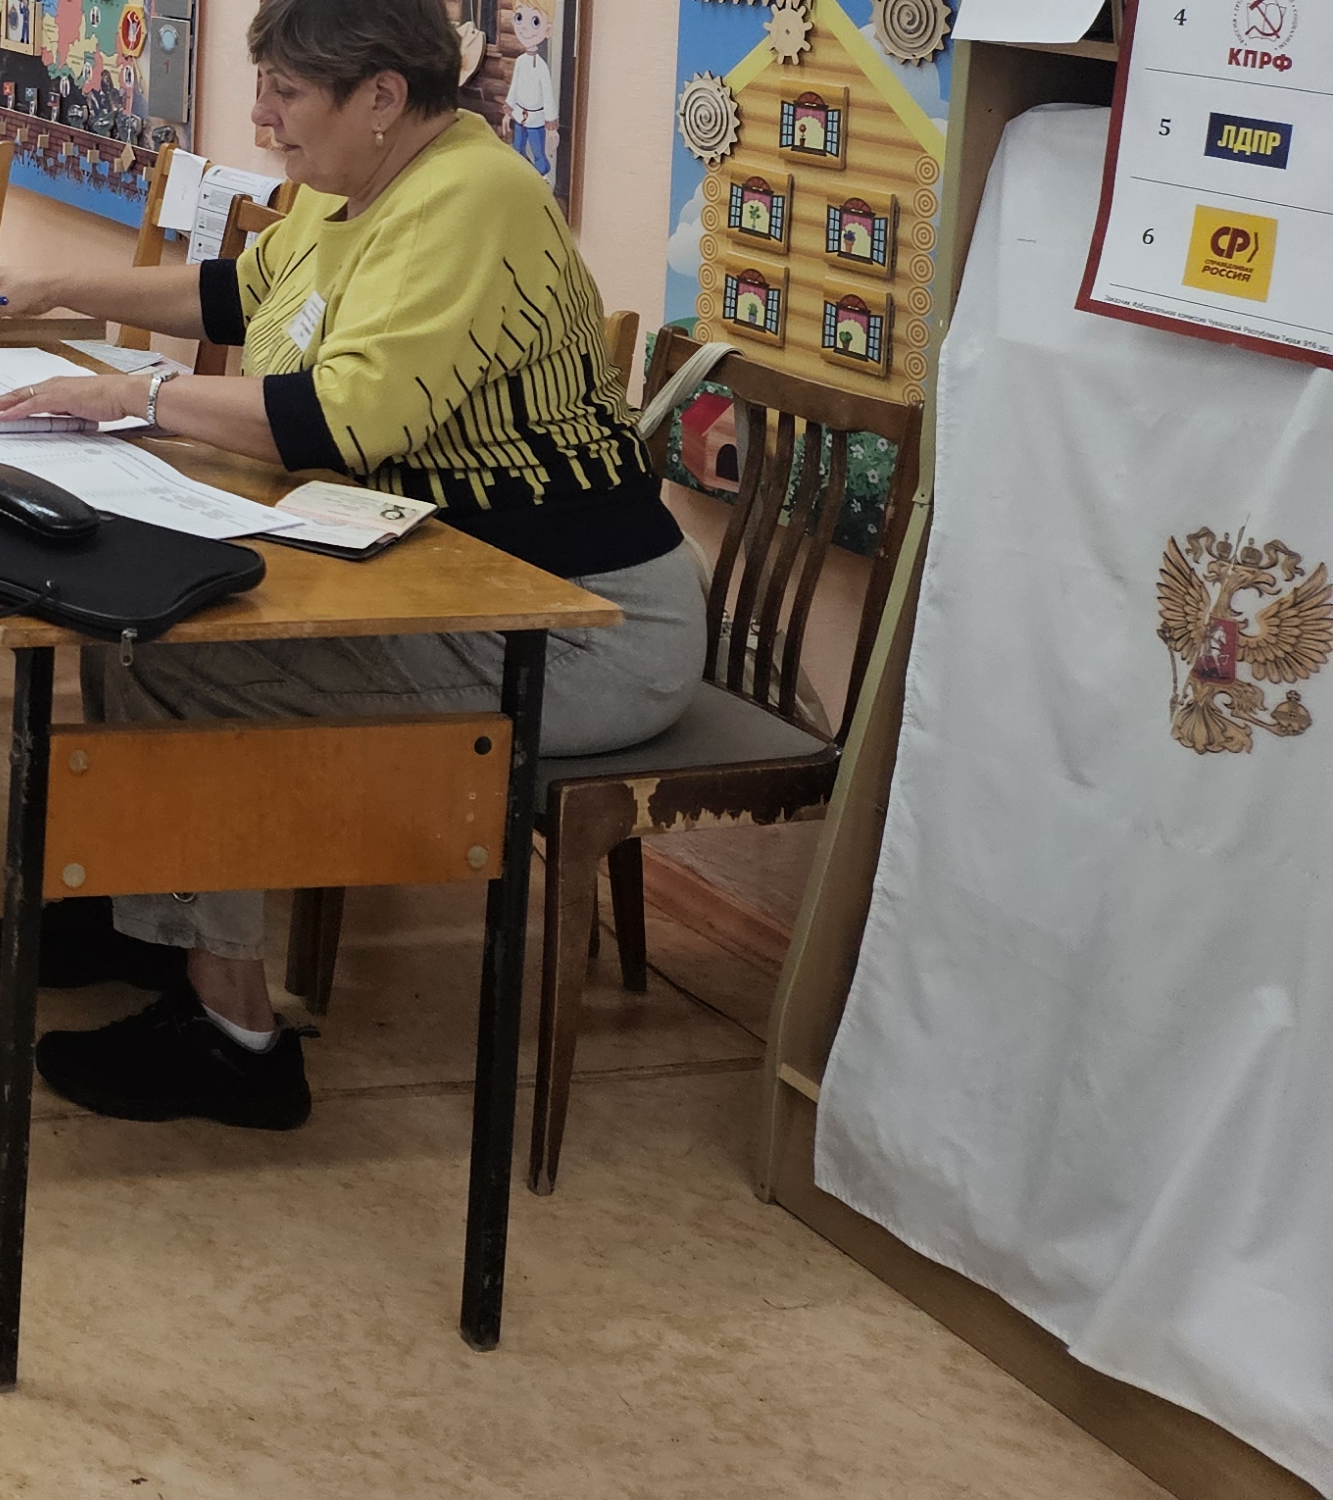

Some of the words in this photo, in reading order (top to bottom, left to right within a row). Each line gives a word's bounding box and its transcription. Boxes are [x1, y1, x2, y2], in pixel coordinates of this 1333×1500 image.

[1174, 8, 1187, 26] 4
[1228, 47, 1293, 72] КПРФ
[1158, 118, 1171, 136] 5
[1217, 124, 1281, 156] ЛДПР
[1142, 228, 1155, 244] 6
[1201, 265, 1251, 283] РОССИЯ
[1178, 313, 1207, 324] комиссия
[1208, 318, 1242, 332] Чувашской
[1243, 325, 1280, 340] Республики
